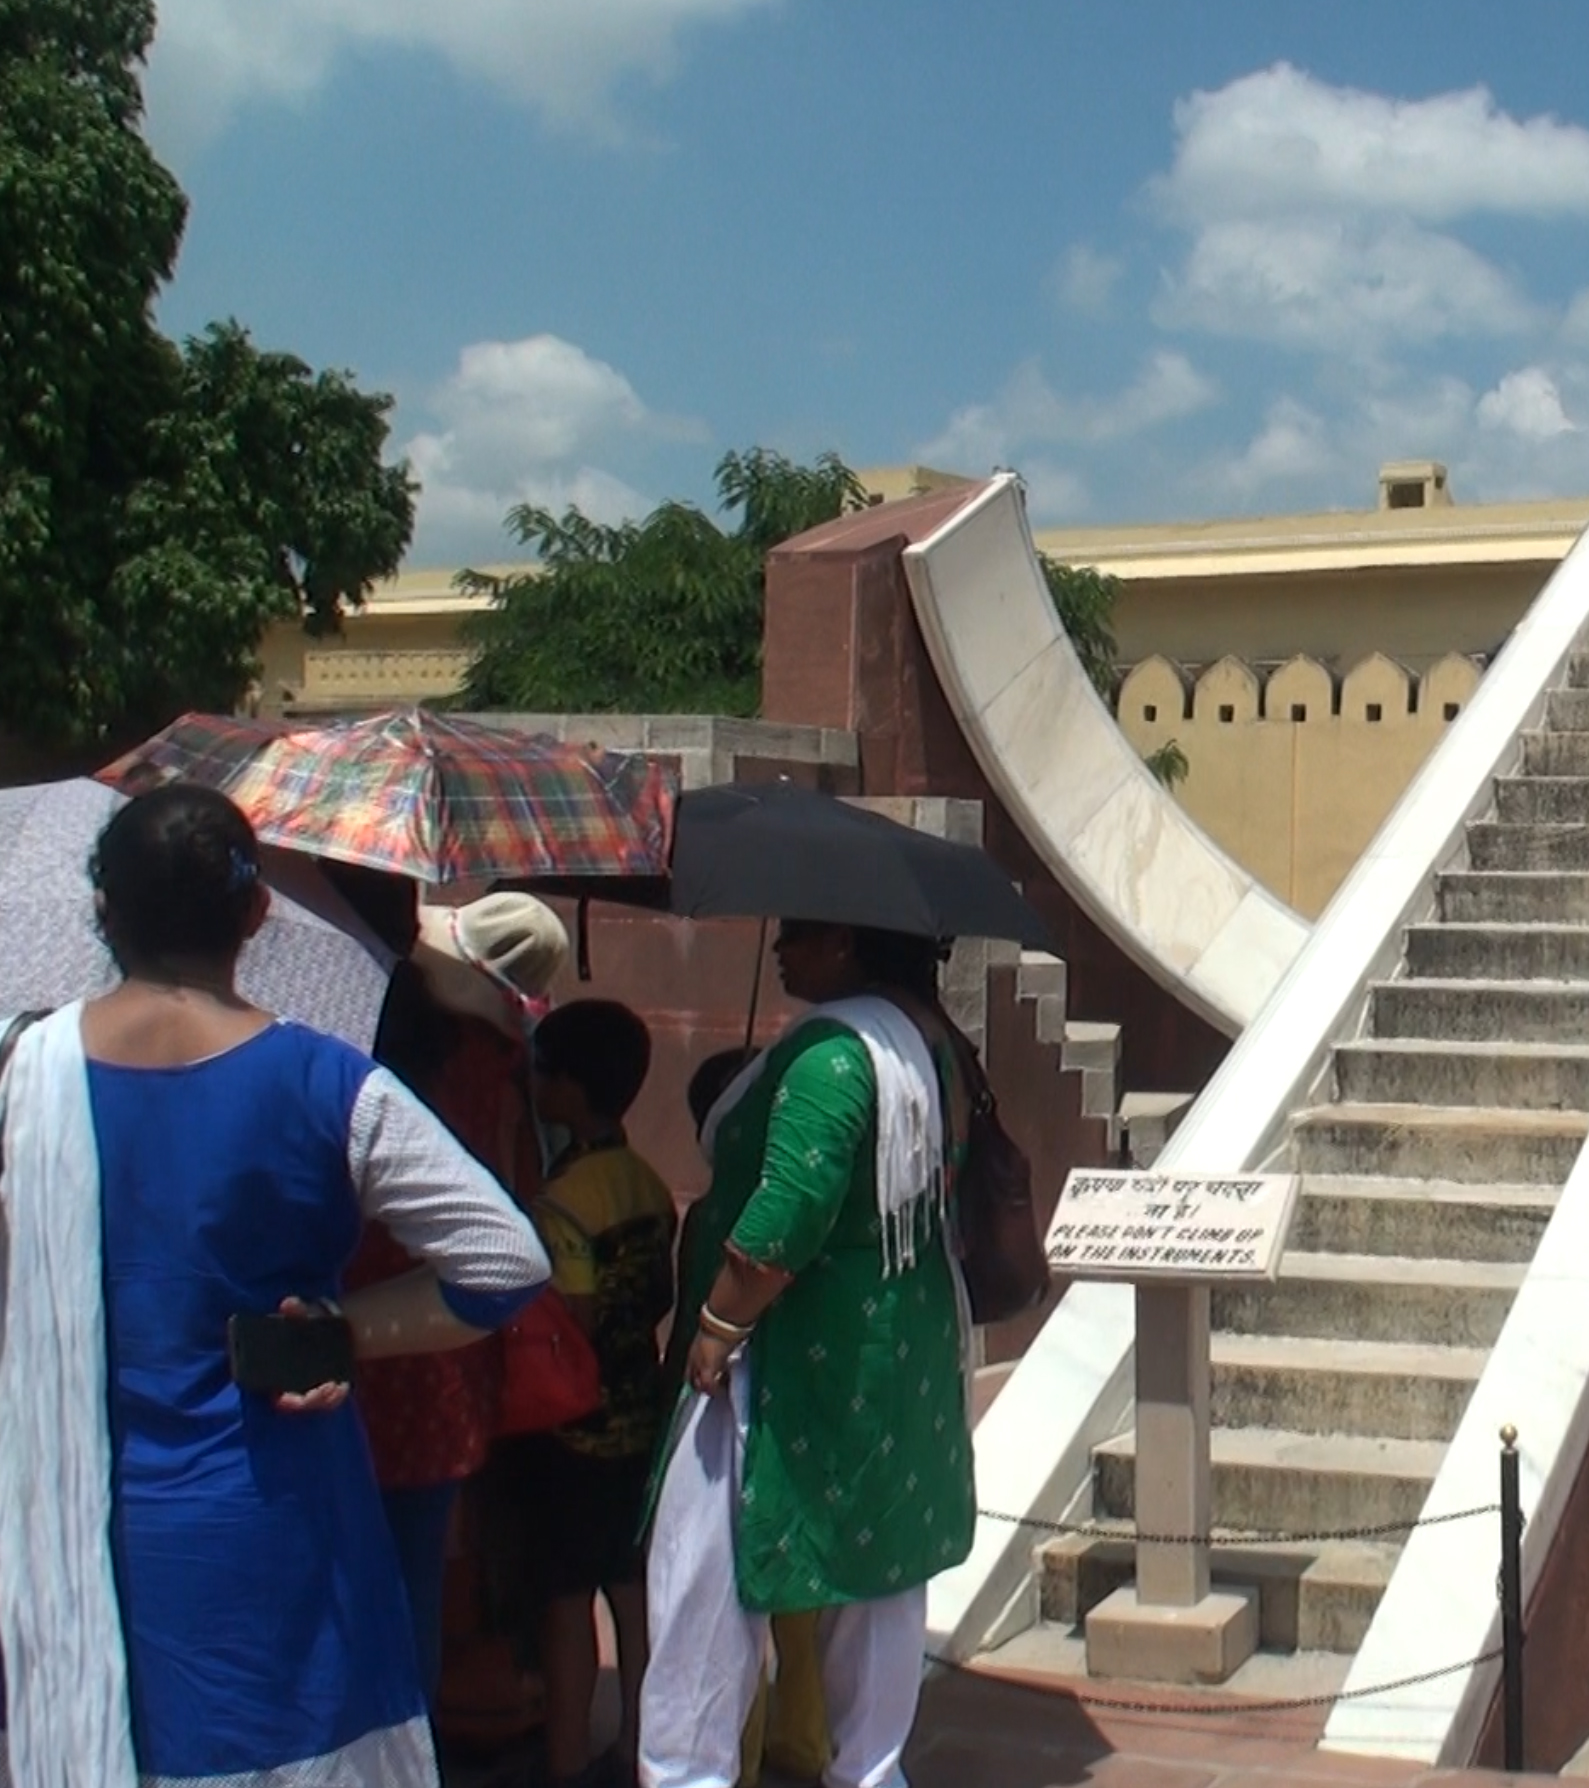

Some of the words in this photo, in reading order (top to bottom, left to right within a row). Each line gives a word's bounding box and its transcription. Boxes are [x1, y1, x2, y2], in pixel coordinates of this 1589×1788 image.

[1052, 1223, 1120, 1239] PLEASE
[1121, 1225, 1175, 1240] DON'T
[1176, 1227, 1235, 1243] CLIMB
[1235, 1228, 1264, 1243] UP
[1048, 1244, 1078, 1259] ON
[1080, 1245, 1117, 1260] THE
